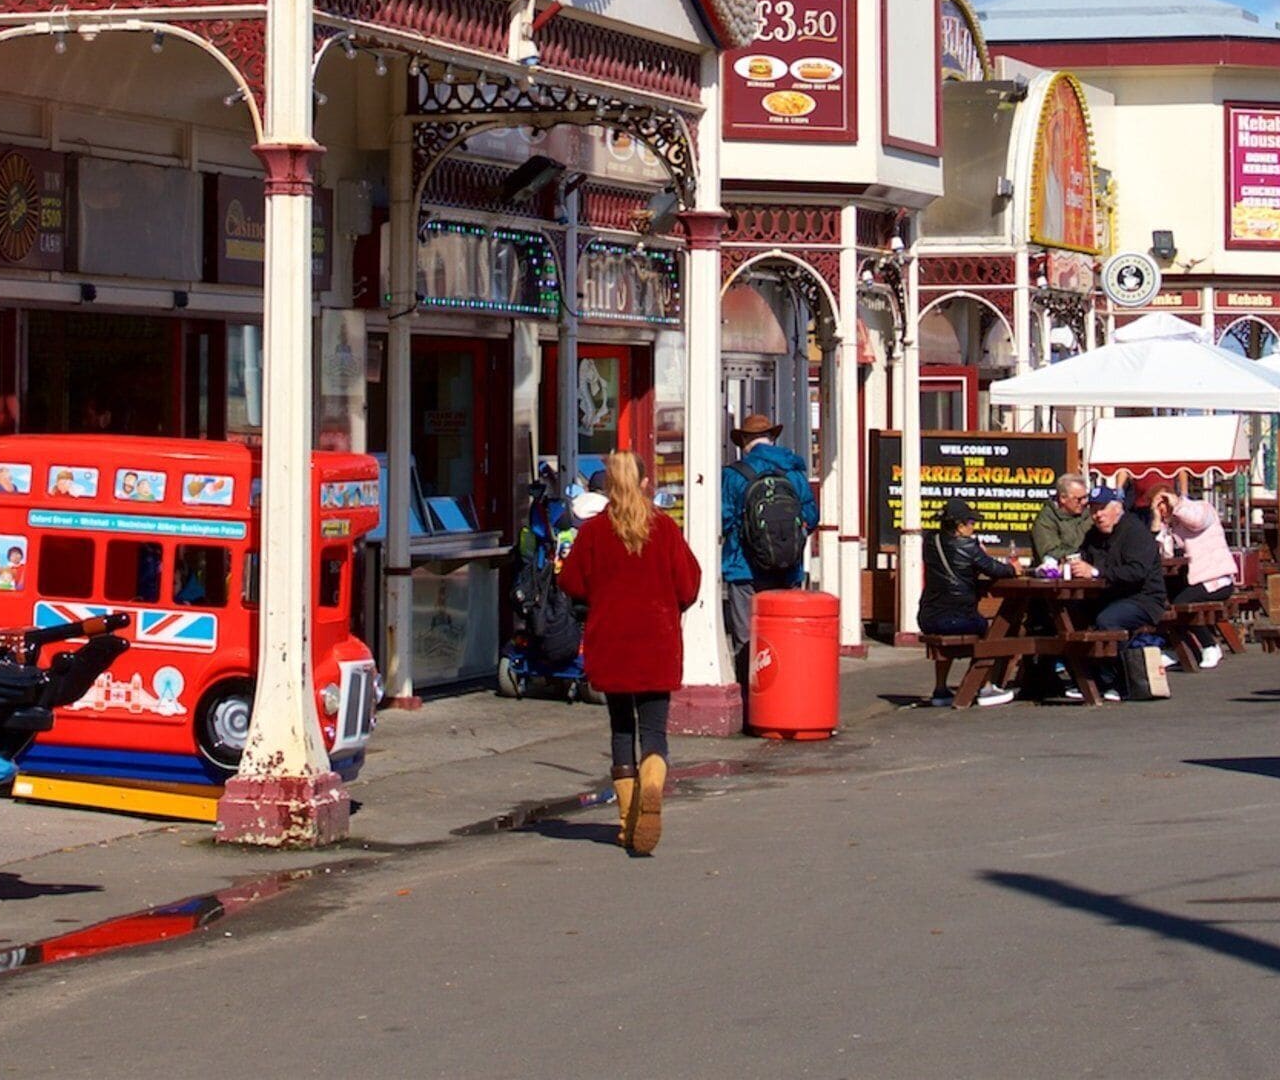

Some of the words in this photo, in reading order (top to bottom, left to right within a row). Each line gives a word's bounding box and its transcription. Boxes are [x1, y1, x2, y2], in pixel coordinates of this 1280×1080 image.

[753, 1, 838, 42] £3.50
[1228, 293, 1272, 306] Kebabs
[940, 445, 992, 456] WELCOME
[994, 446, 1009, 456] TO
[964, 457, 984, 466] THE
[966, 466, 1056, 485] ENGLAND
[954, 487, 976, 498] FOR
[978, 488, 1026, 498] PATRONS
